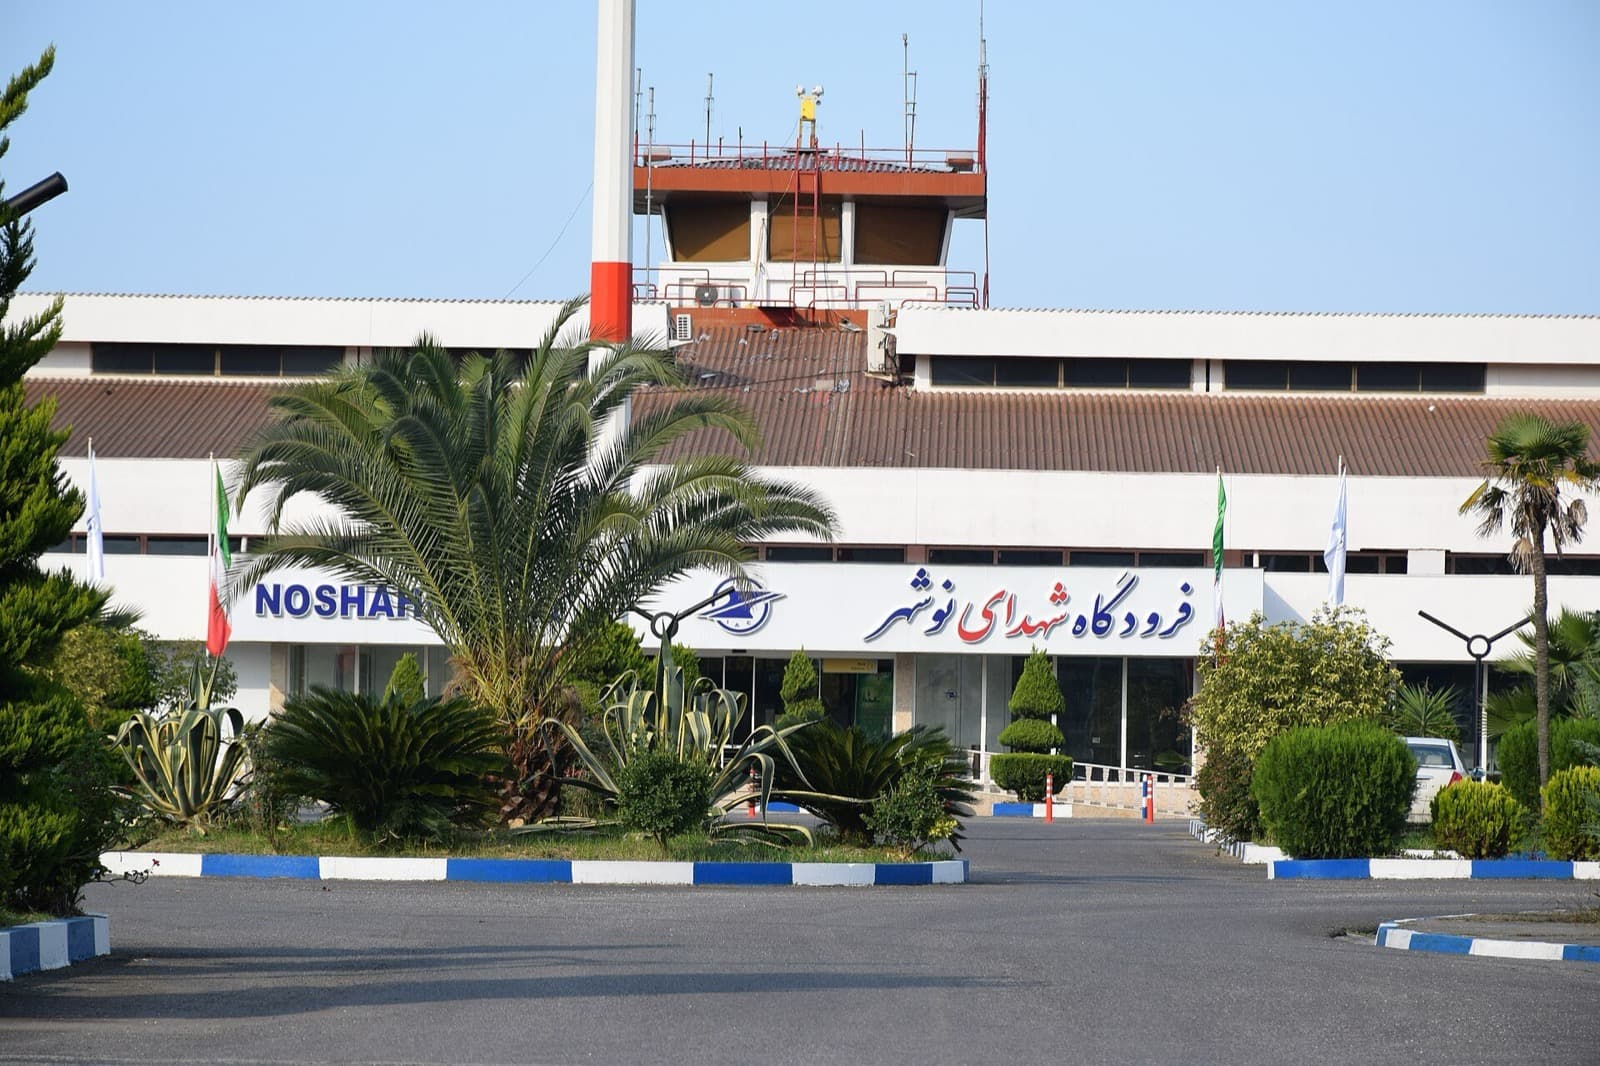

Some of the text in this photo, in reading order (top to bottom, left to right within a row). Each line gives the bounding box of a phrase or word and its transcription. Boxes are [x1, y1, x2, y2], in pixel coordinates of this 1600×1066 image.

[255, 583, 433, 617] NOSHAH
[864, 567, 1193, 644] فرودگاه شهدای نوشهر
